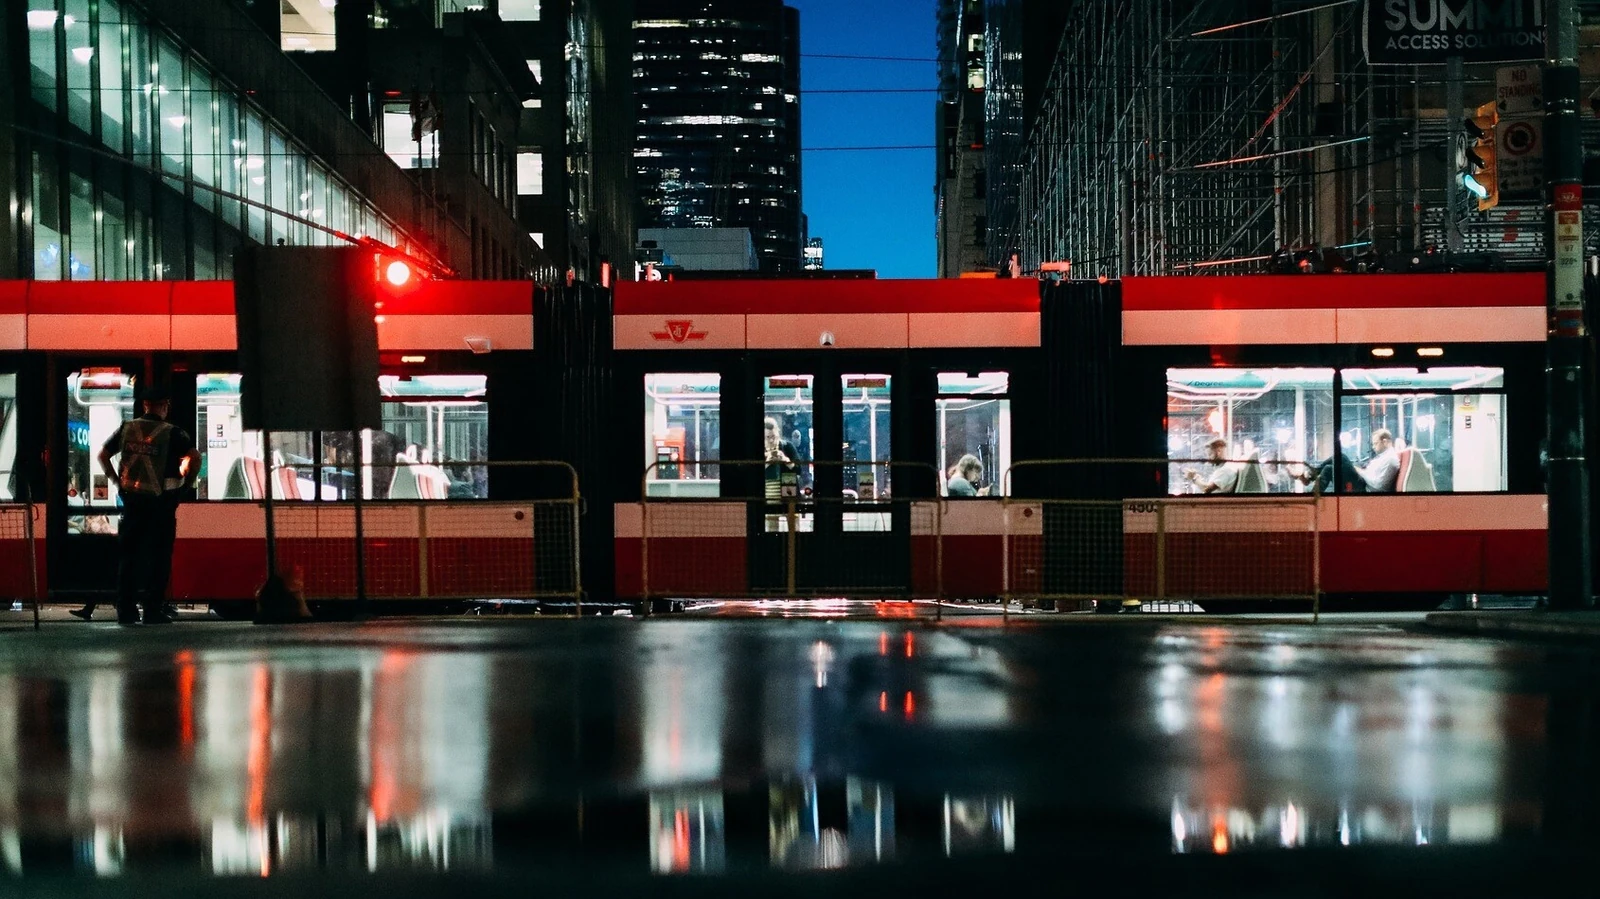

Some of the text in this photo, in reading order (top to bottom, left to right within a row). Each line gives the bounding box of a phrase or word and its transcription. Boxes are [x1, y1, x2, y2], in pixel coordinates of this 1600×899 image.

[1385, 0, 1542, 31] SUMMIT
[1386, 34, 1450, 50] ACCESS
[1512, 70, 1527, 81] NO
[1498, 84, 1541, 98] STANDING
